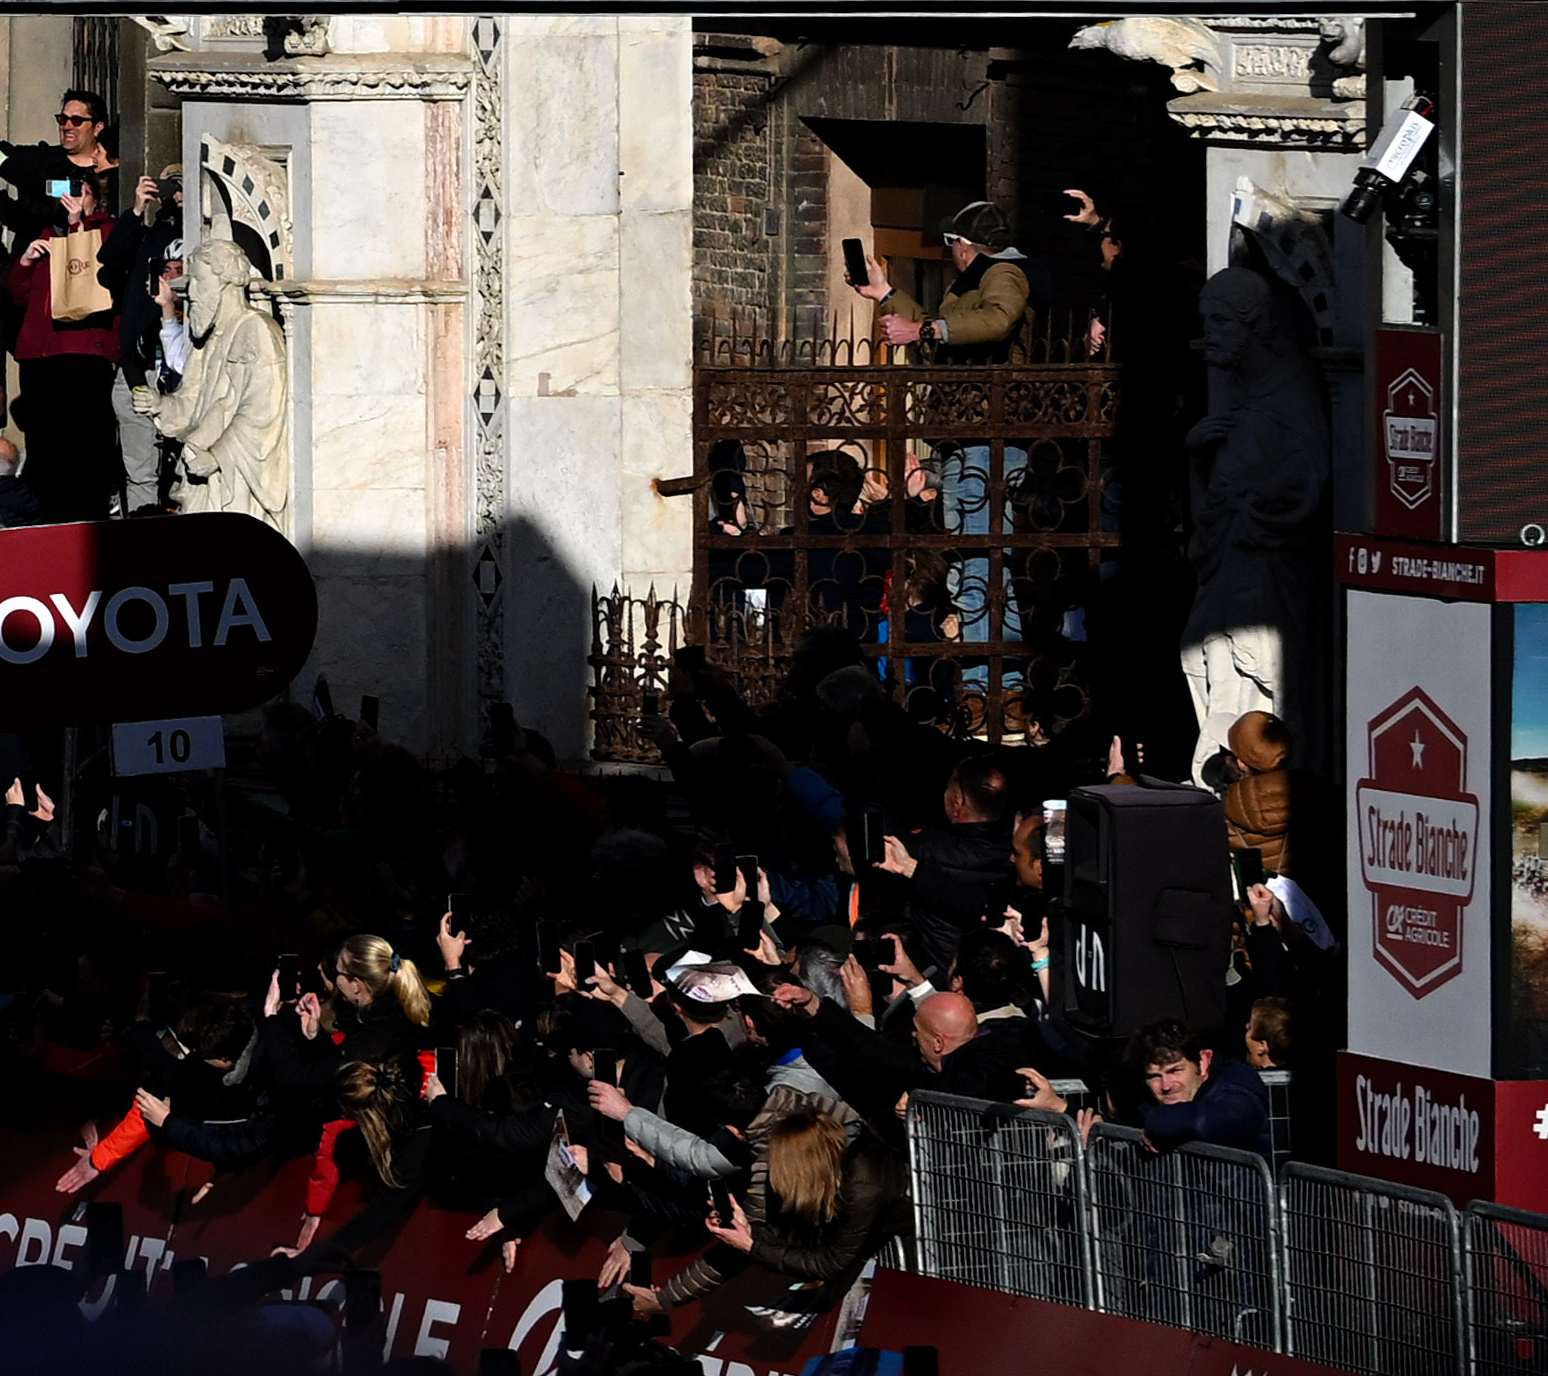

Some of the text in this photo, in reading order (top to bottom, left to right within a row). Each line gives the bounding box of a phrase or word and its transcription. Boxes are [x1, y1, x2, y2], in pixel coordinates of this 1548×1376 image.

[1391, 554, 1486, 585] STRADE-BIANCHE.IT
[147, 728, 191, 764] 10
[1367, 805, 1468, 882] Strade Bianche
[1405, 904, 1438, 930] CRÉDIT
[1405, 926, 1450, 948] AGRICOLE
[1356, 1073, 1412, 1161] Strade
[1414, 1084, 1481, 1175] Bianche
